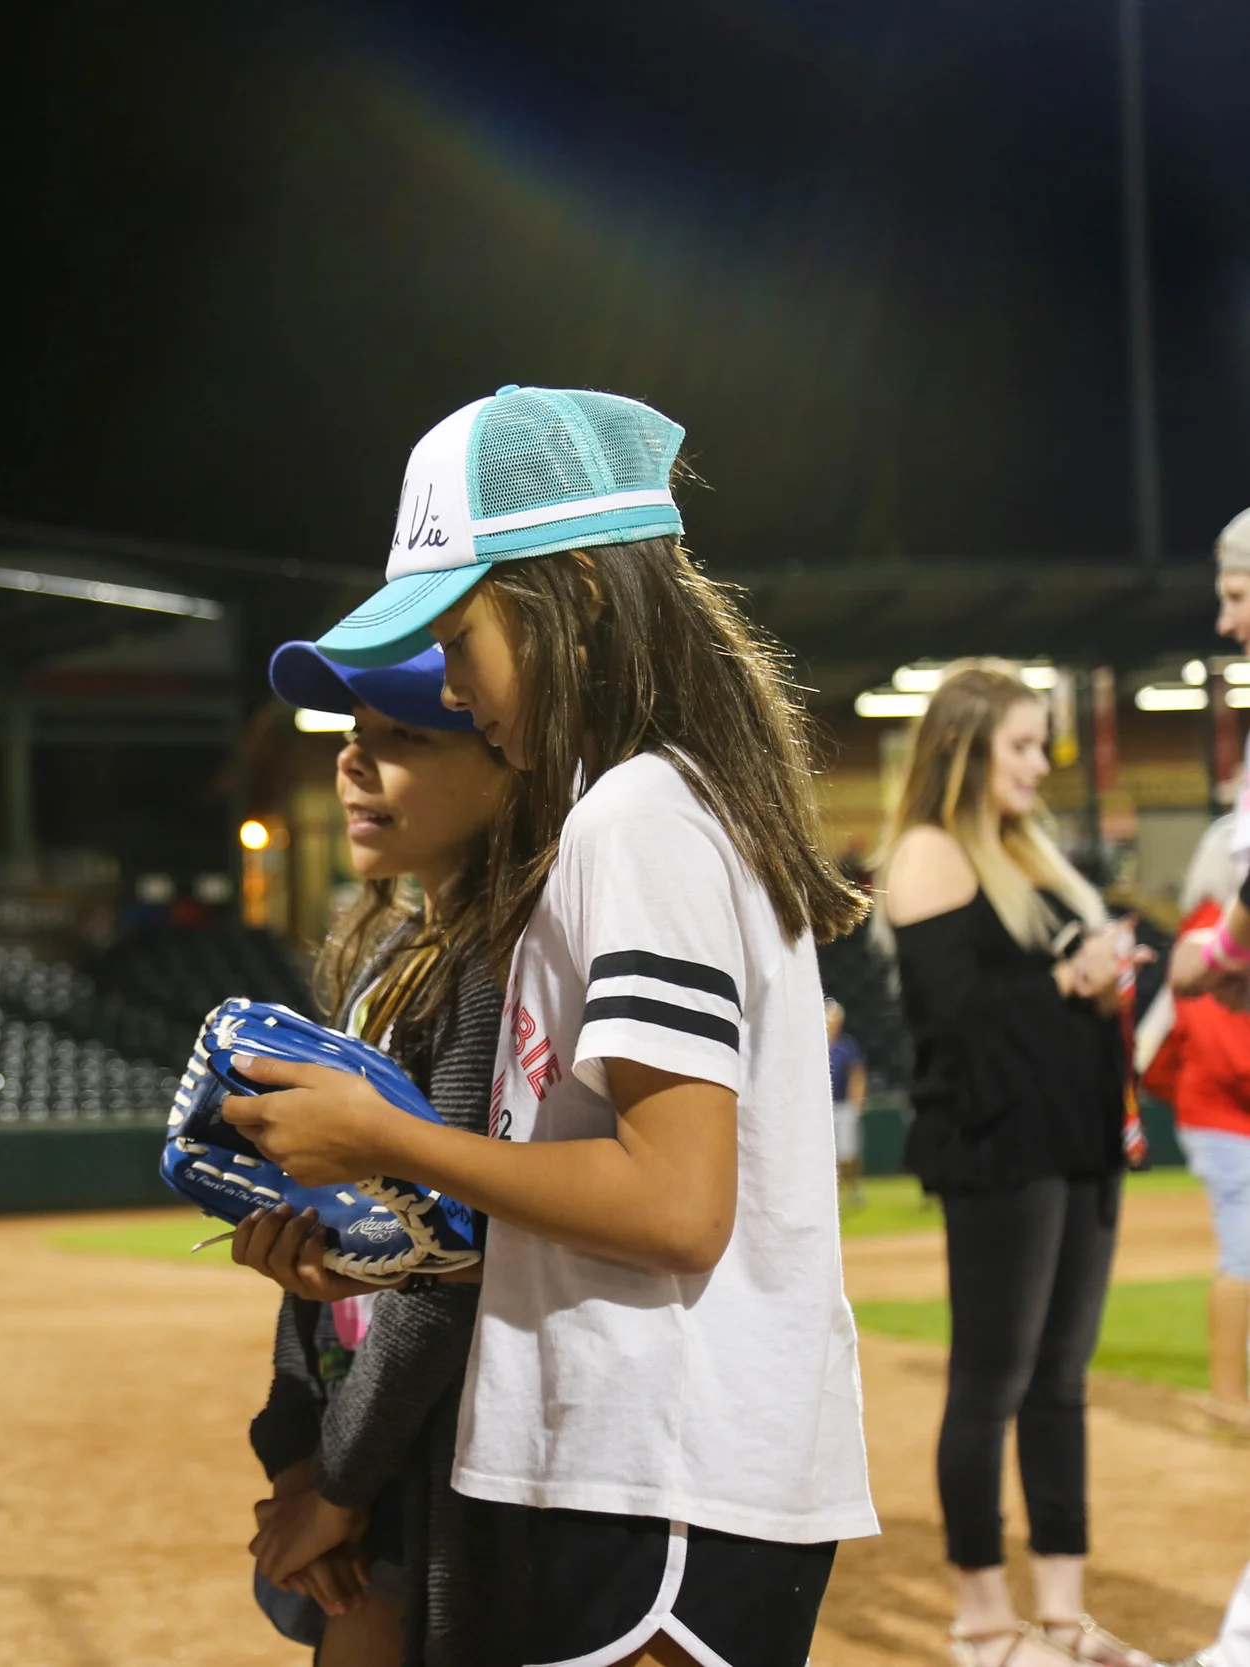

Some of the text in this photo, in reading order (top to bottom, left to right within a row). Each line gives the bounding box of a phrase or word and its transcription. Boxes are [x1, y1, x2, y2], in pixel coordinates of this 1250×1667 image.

[408, 483, 449, 550] Vie
[511, 997, 563, 1102] BIE
[198, 1175, 224, 1190] Finest
